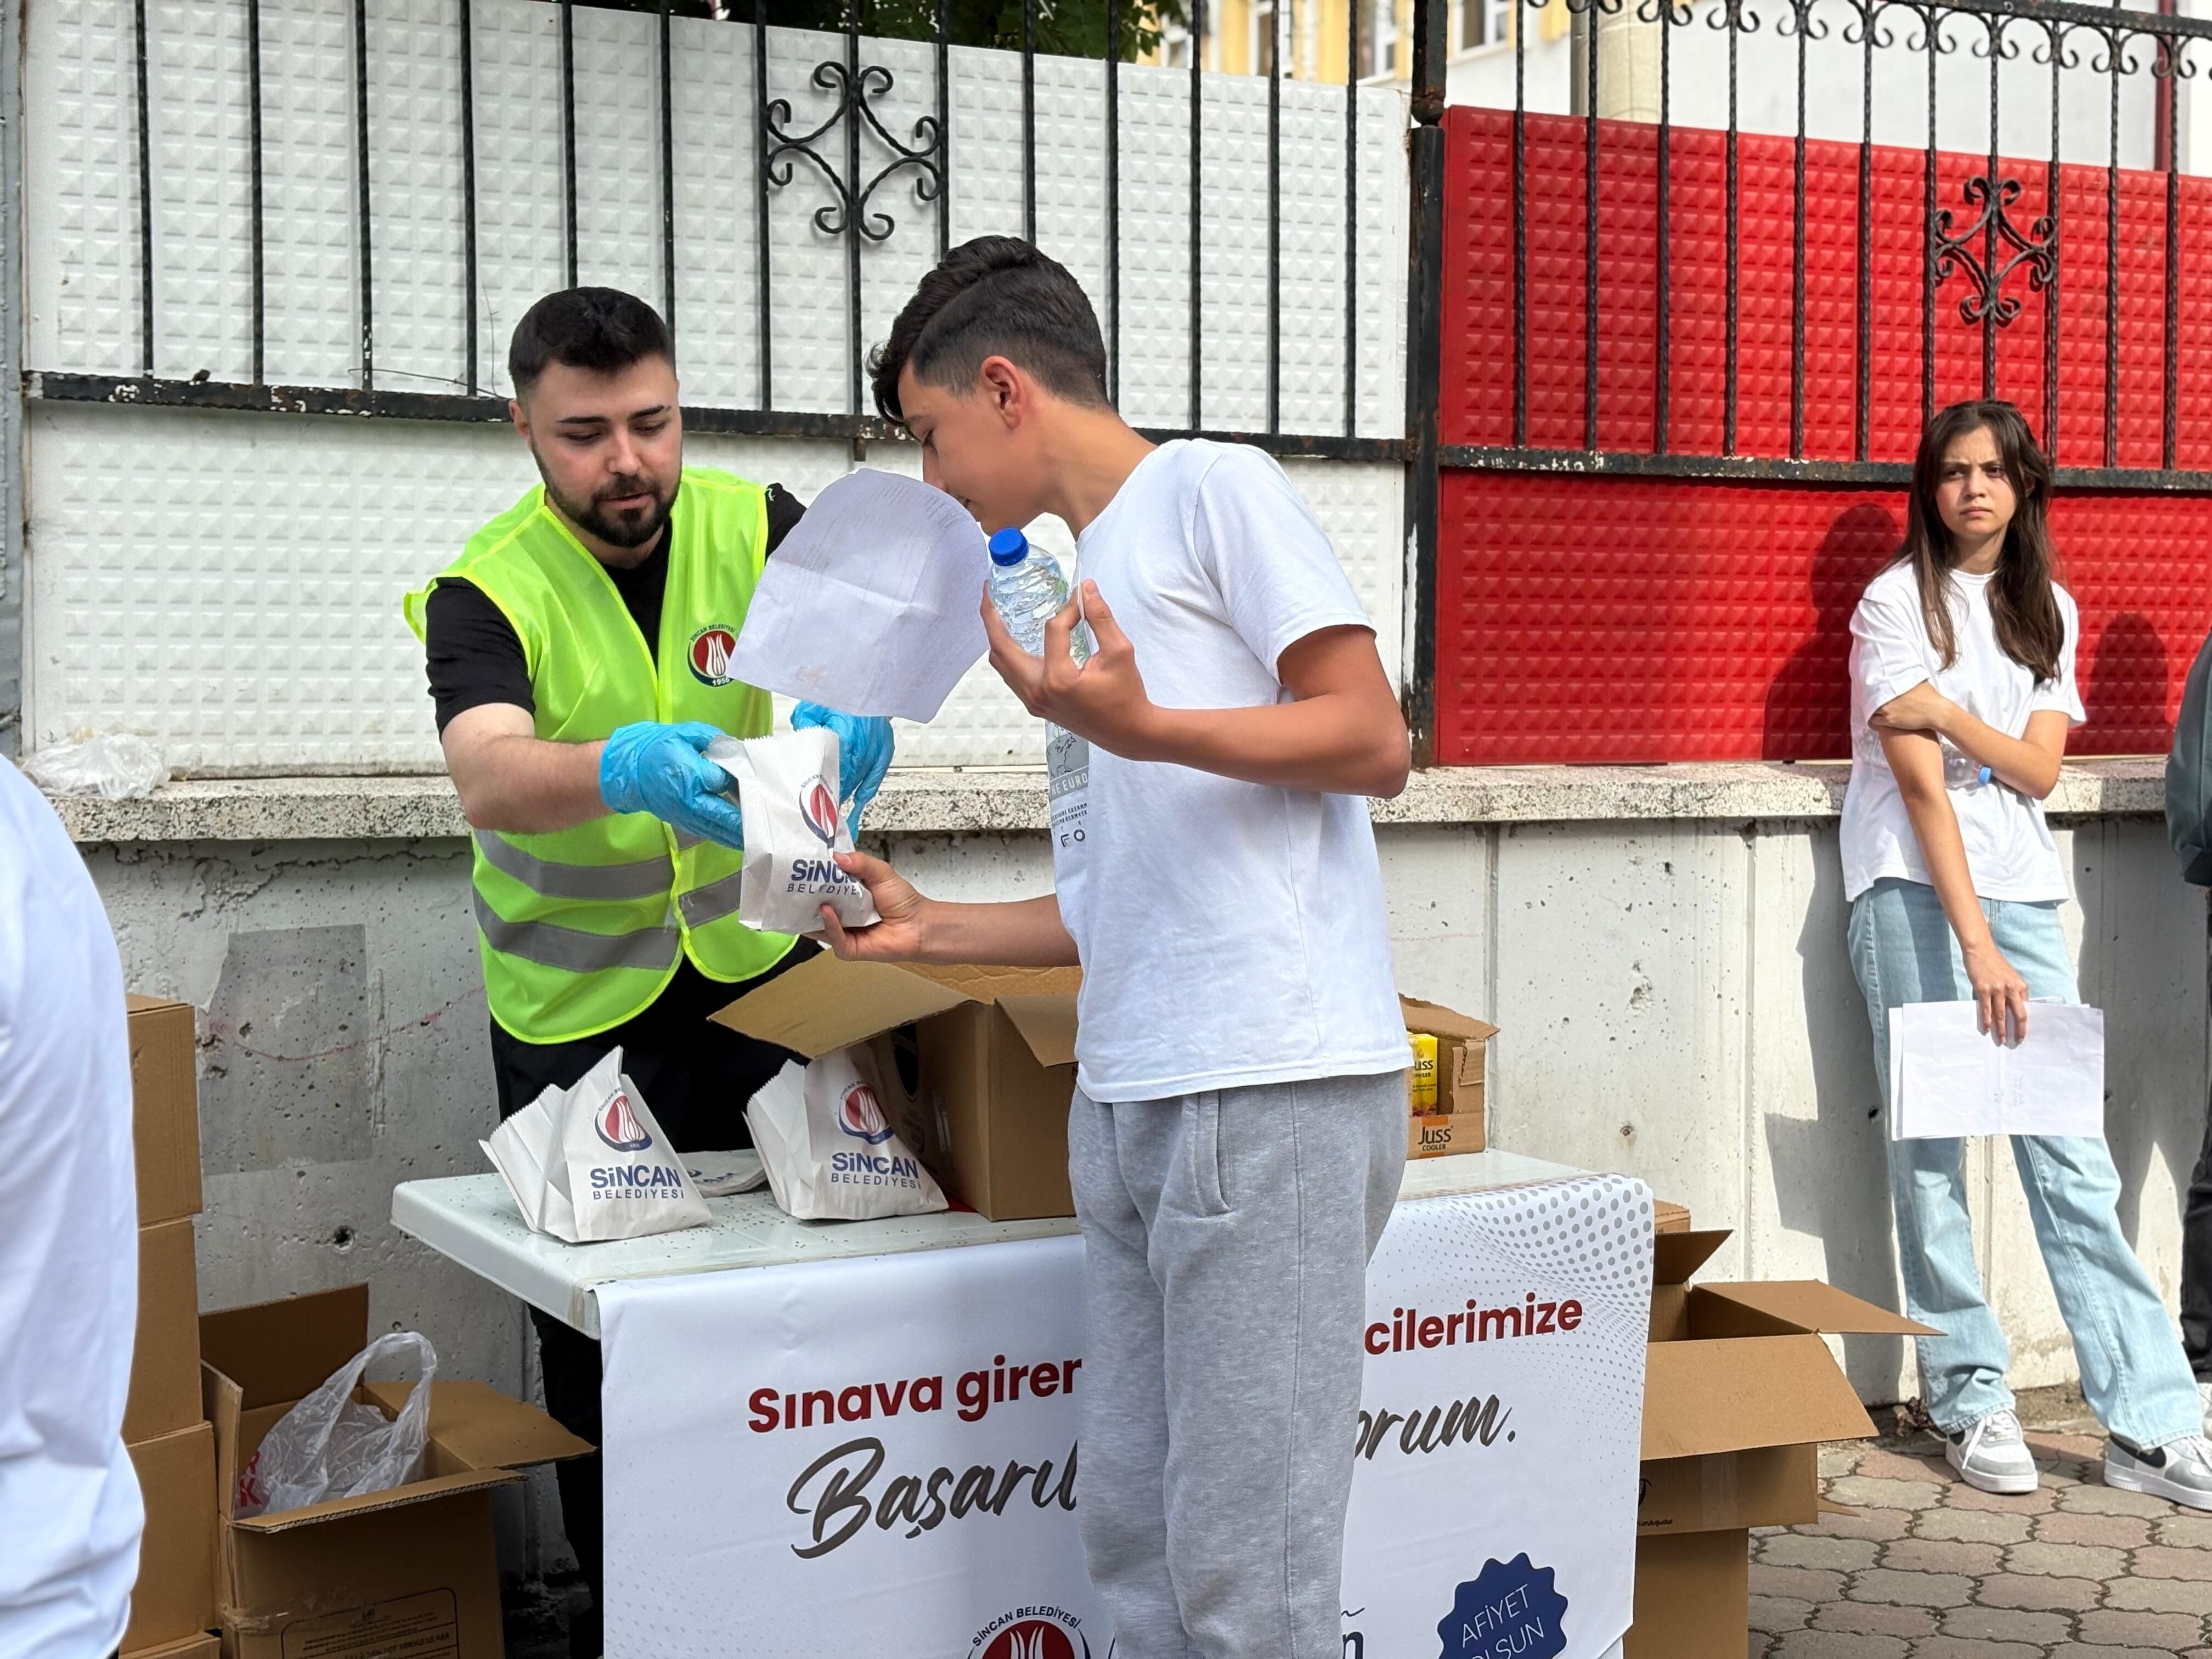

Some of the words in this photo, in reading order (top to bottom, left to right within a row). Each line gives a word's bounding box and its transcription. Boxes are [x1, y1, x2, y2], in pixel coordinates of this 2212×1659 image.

[1414, 1059, 1434, 1071] uss
[1422, 1143, 1447, 1152] COOLER
[748, 1375, 943, 1433] Sınava
[972, 1611, 1013, 1647] SİNCAN
[1016, 1606, 1082, 1629] BELEDİYESİ
[1471, 1616, 1545, 1659] SUN
